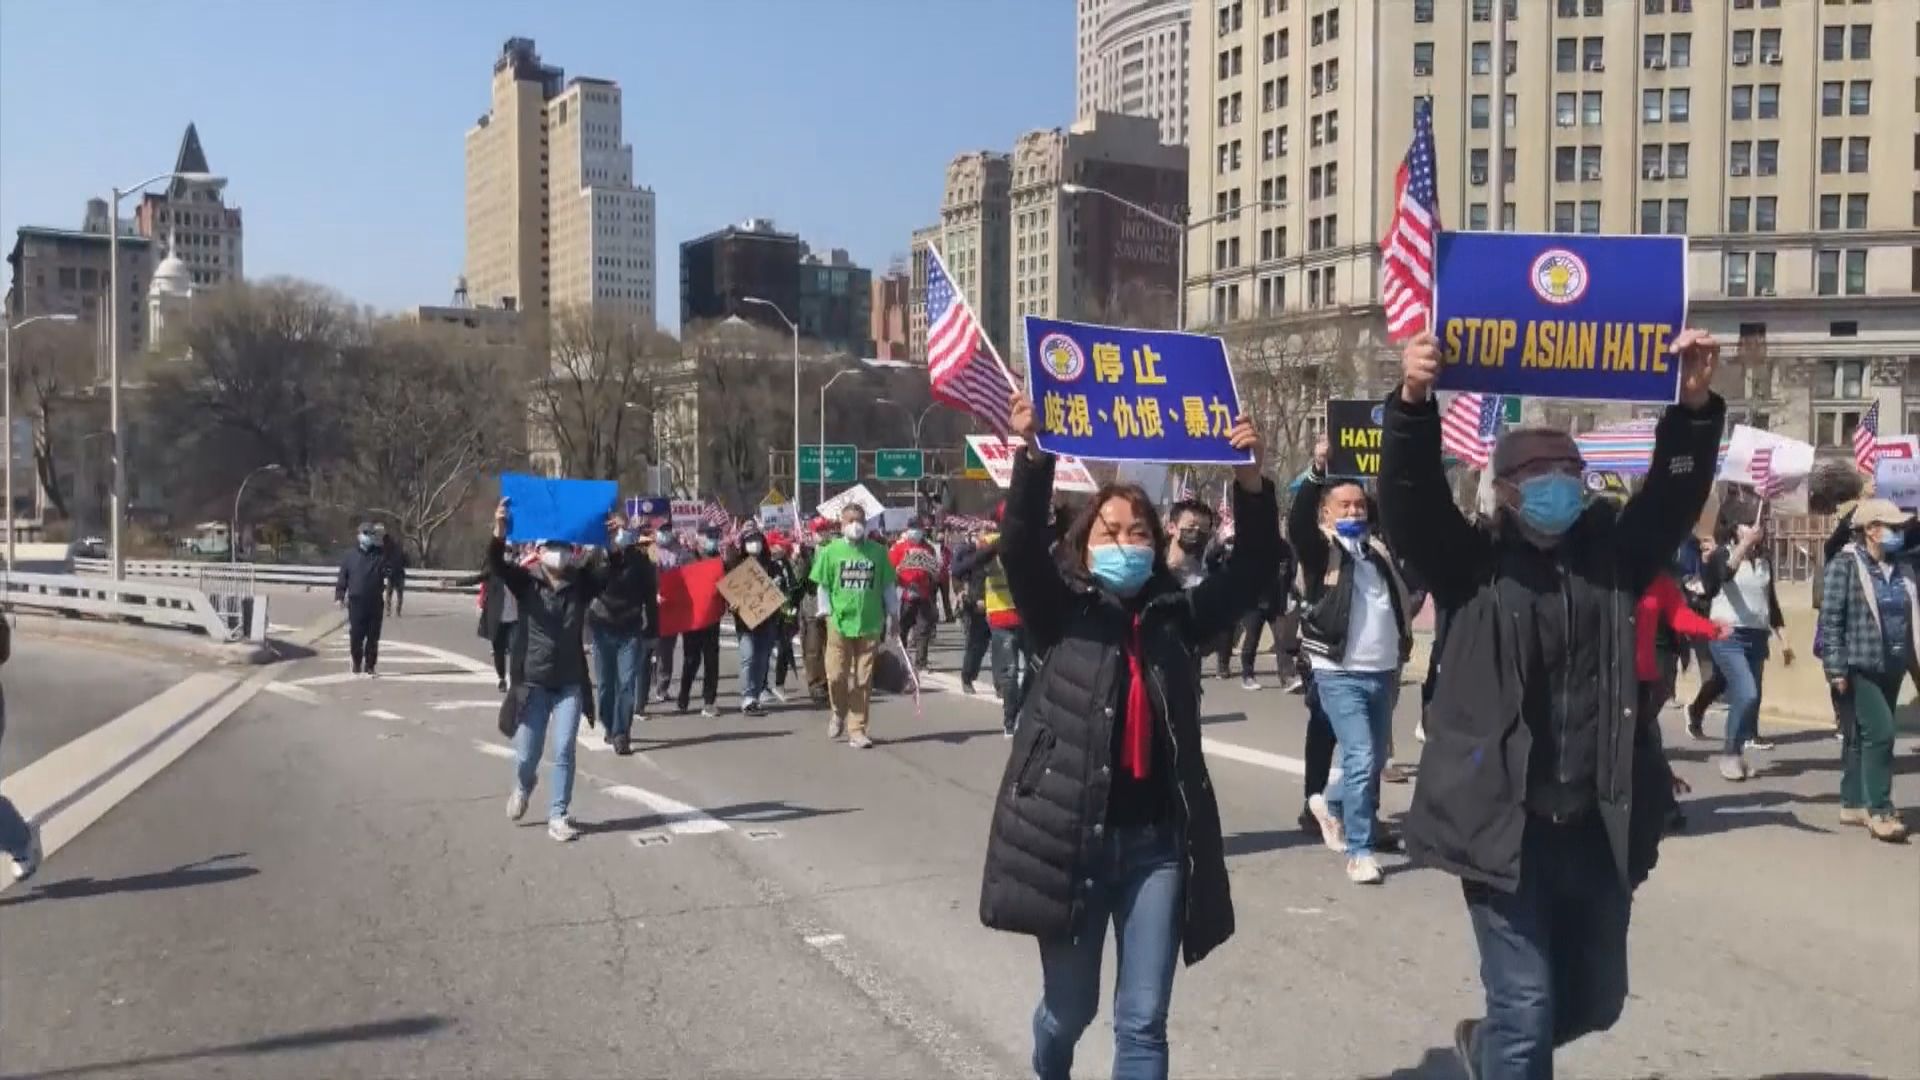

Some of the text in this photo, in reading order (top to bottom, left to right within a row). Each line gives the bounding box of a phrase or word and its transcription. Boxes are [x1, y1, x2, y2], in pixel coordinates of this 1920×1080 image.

[1113, 240, 1171, 264] SAVINGS
[1092, 342, 1167, 384] 停止
[1445, 317, 1672, 374] STOP ASIAN HATE
